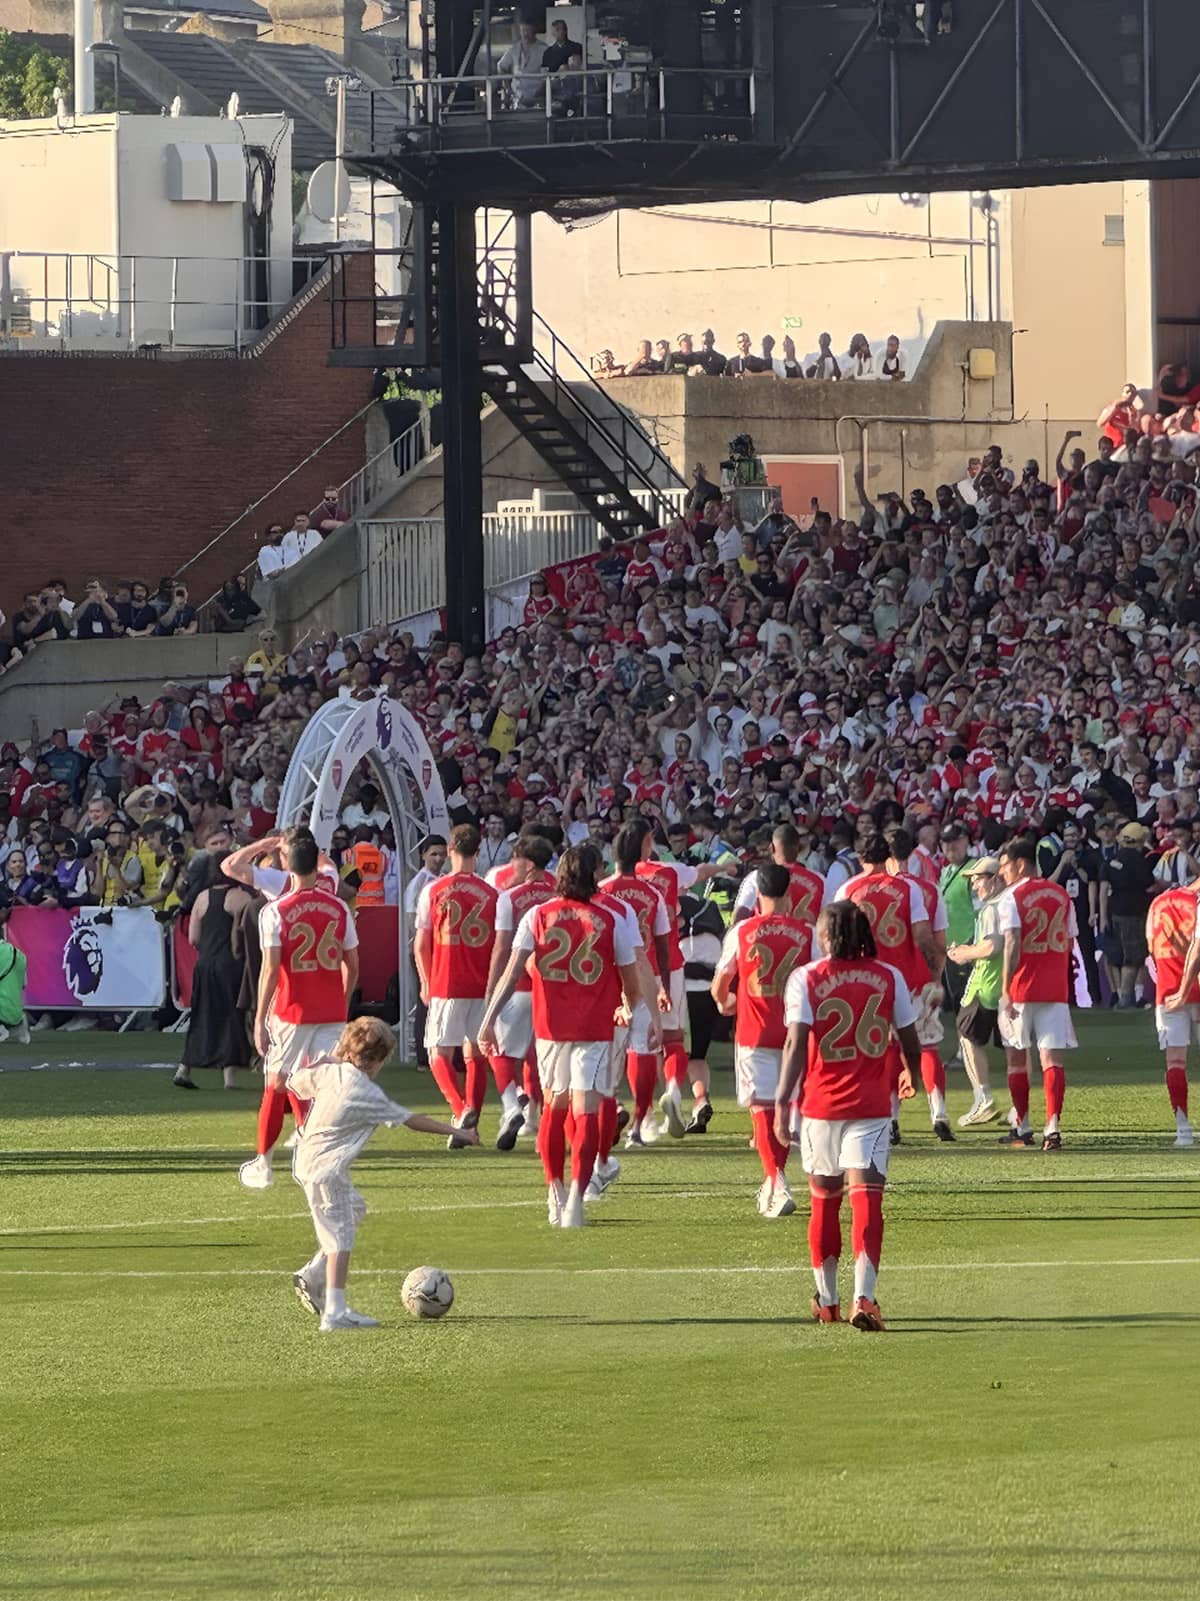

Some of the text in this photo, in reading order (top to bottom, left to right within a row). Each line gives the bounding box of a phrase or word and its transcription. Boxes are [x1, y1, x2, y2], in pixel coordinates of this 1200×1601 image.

[288, 920, 343, 973] 26
[438, 899, 490, 948] 26
[1023, 907, 1068, 953] 26
[540, 926, 603, 985] 26
[816, 996, 889, 1063] 26
